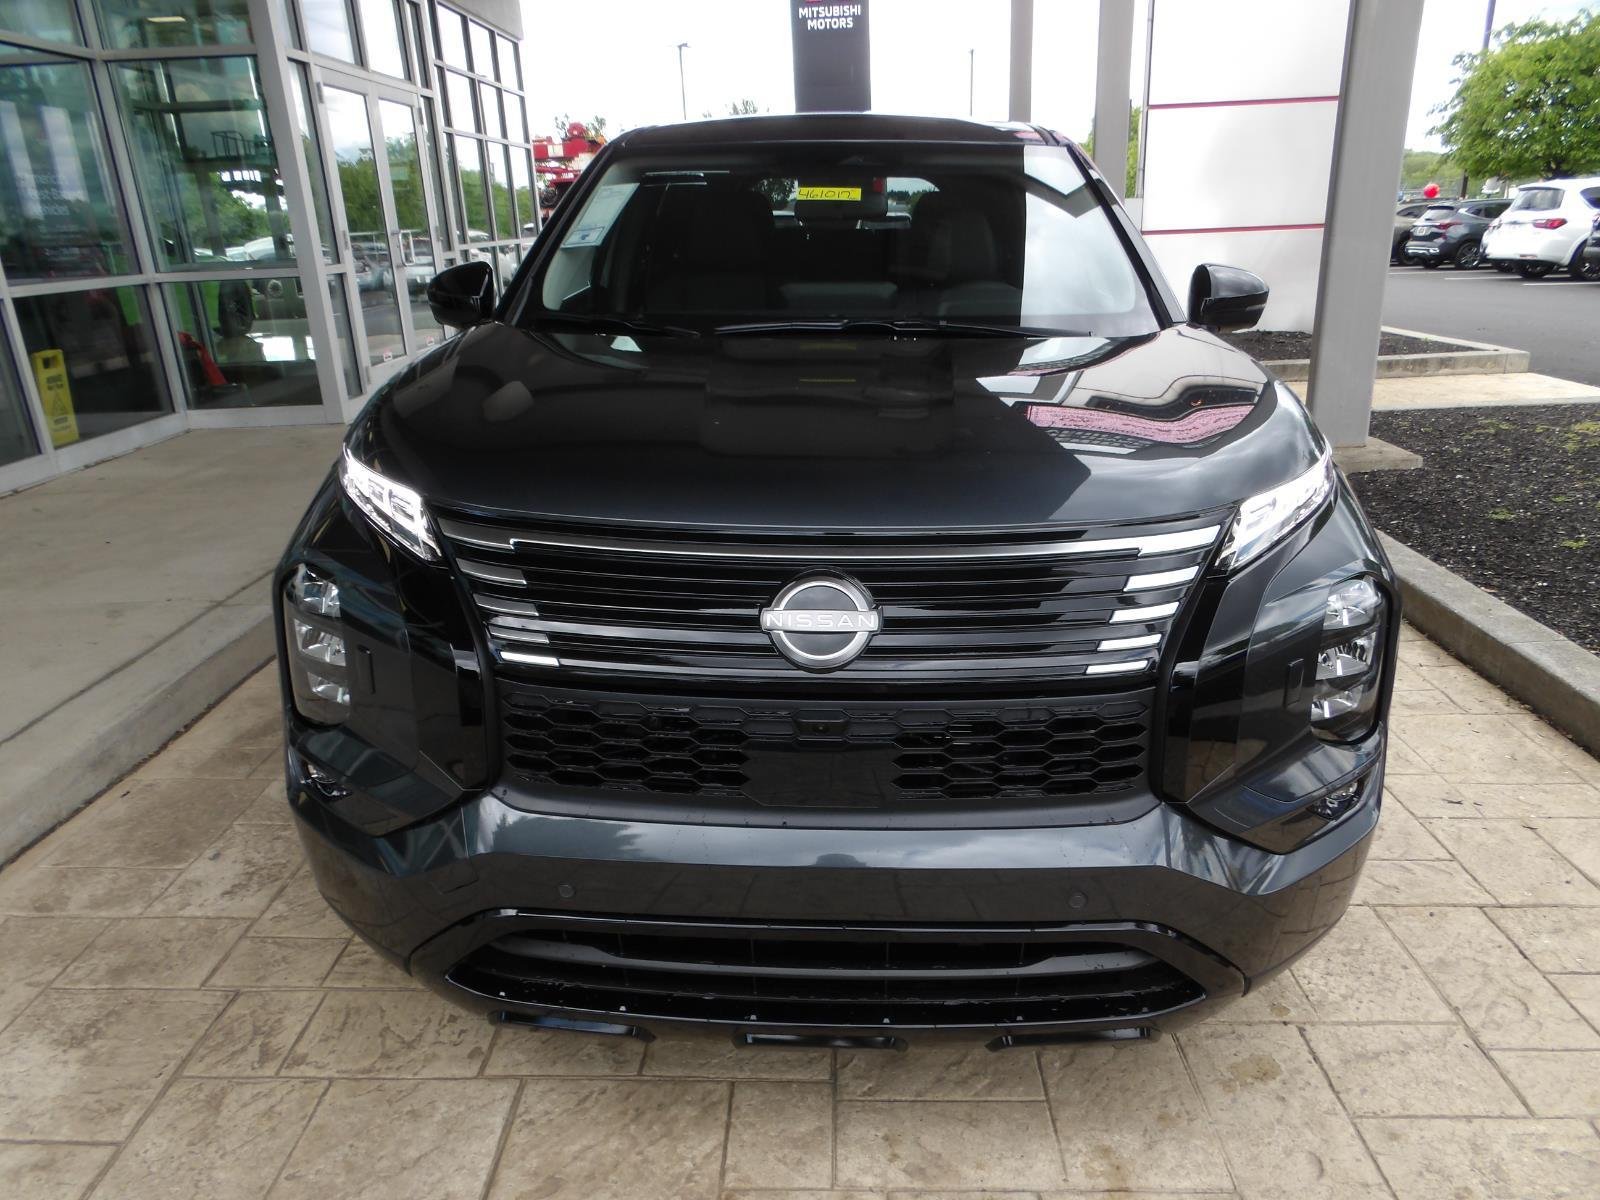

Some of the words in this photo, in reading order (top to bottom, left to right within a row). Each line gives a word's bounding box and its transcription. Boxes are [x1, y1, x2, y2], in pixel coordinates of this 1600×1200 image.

[798, 5, 861, 19] MITSUBISHI
[807, 17, 854, 31] MOTORS
[766, 613, 875, 628] NISSAN
